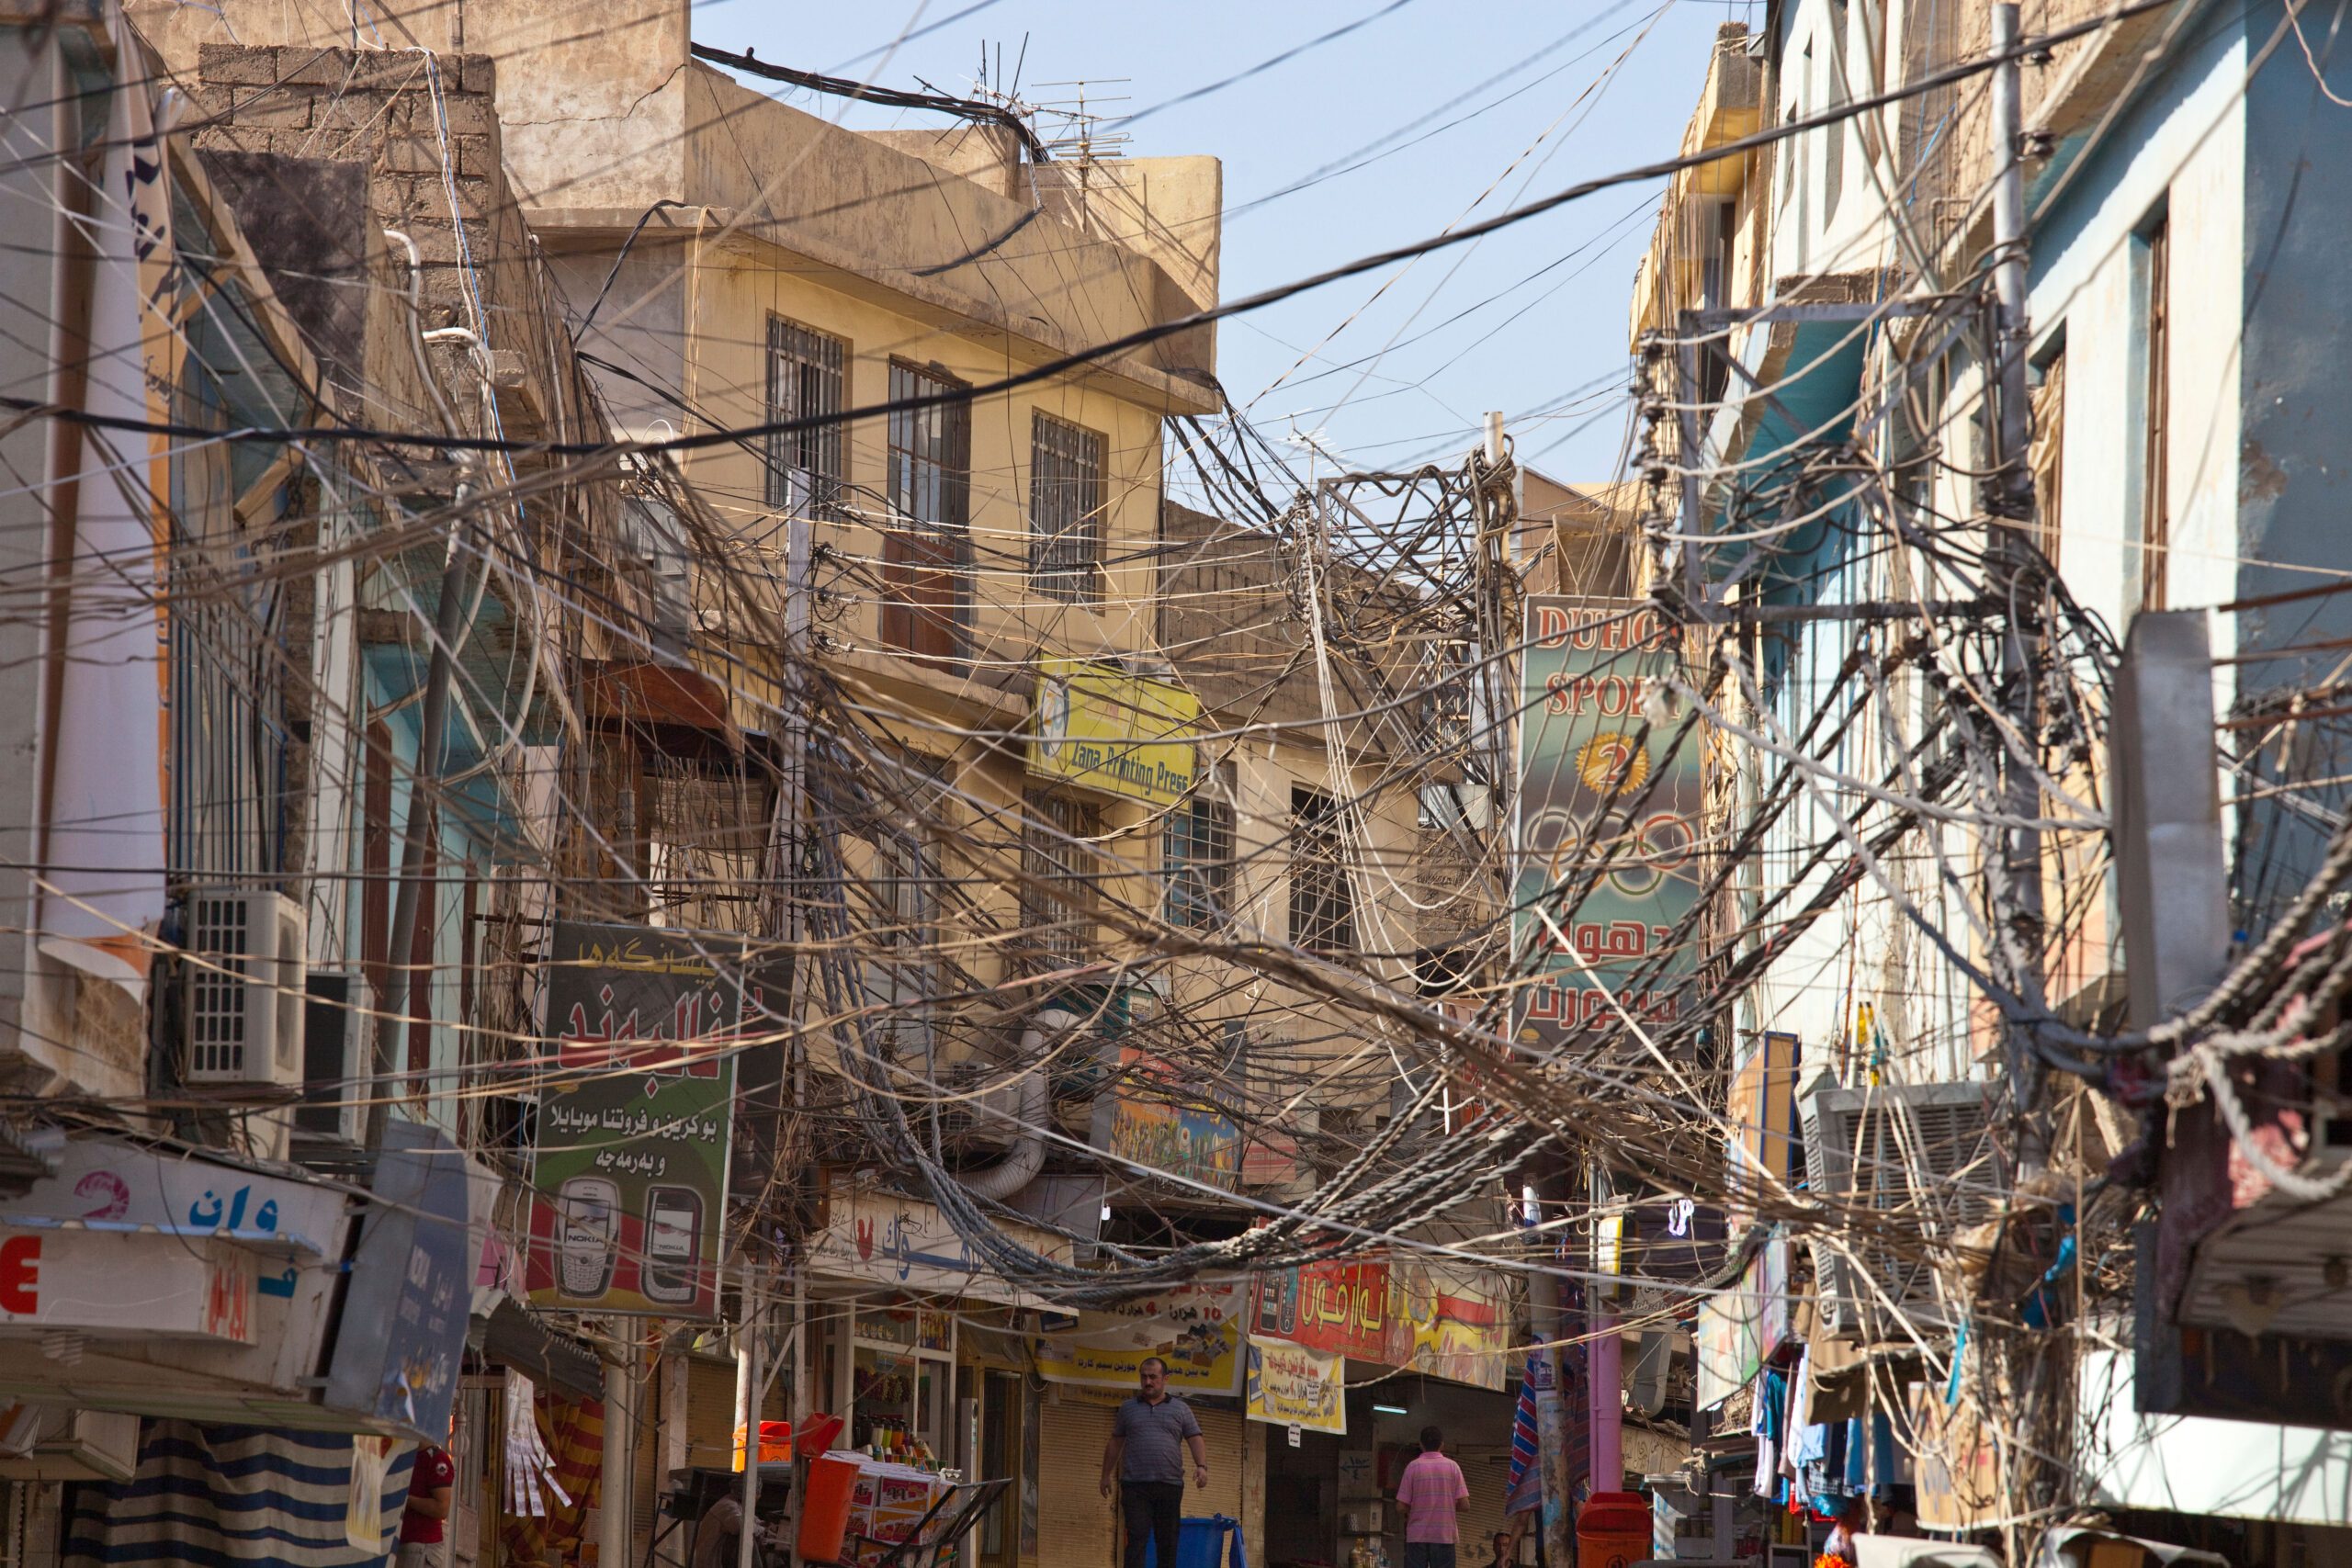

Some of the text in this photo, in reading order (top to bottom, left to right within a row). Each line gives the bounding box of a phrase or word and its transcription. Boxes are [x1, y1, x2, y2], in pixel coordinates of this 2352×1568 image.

[1536, 606, 1702, 653] DUHO
[1544, 671, 1684, 719] SPOR
[1106, 745, 1154, 796] Printing
[1157, 761, 1189, 795] Press
[568, 1234, 604, 1245] NOKIA
[1203, 1306, 1222, 1321] 10
